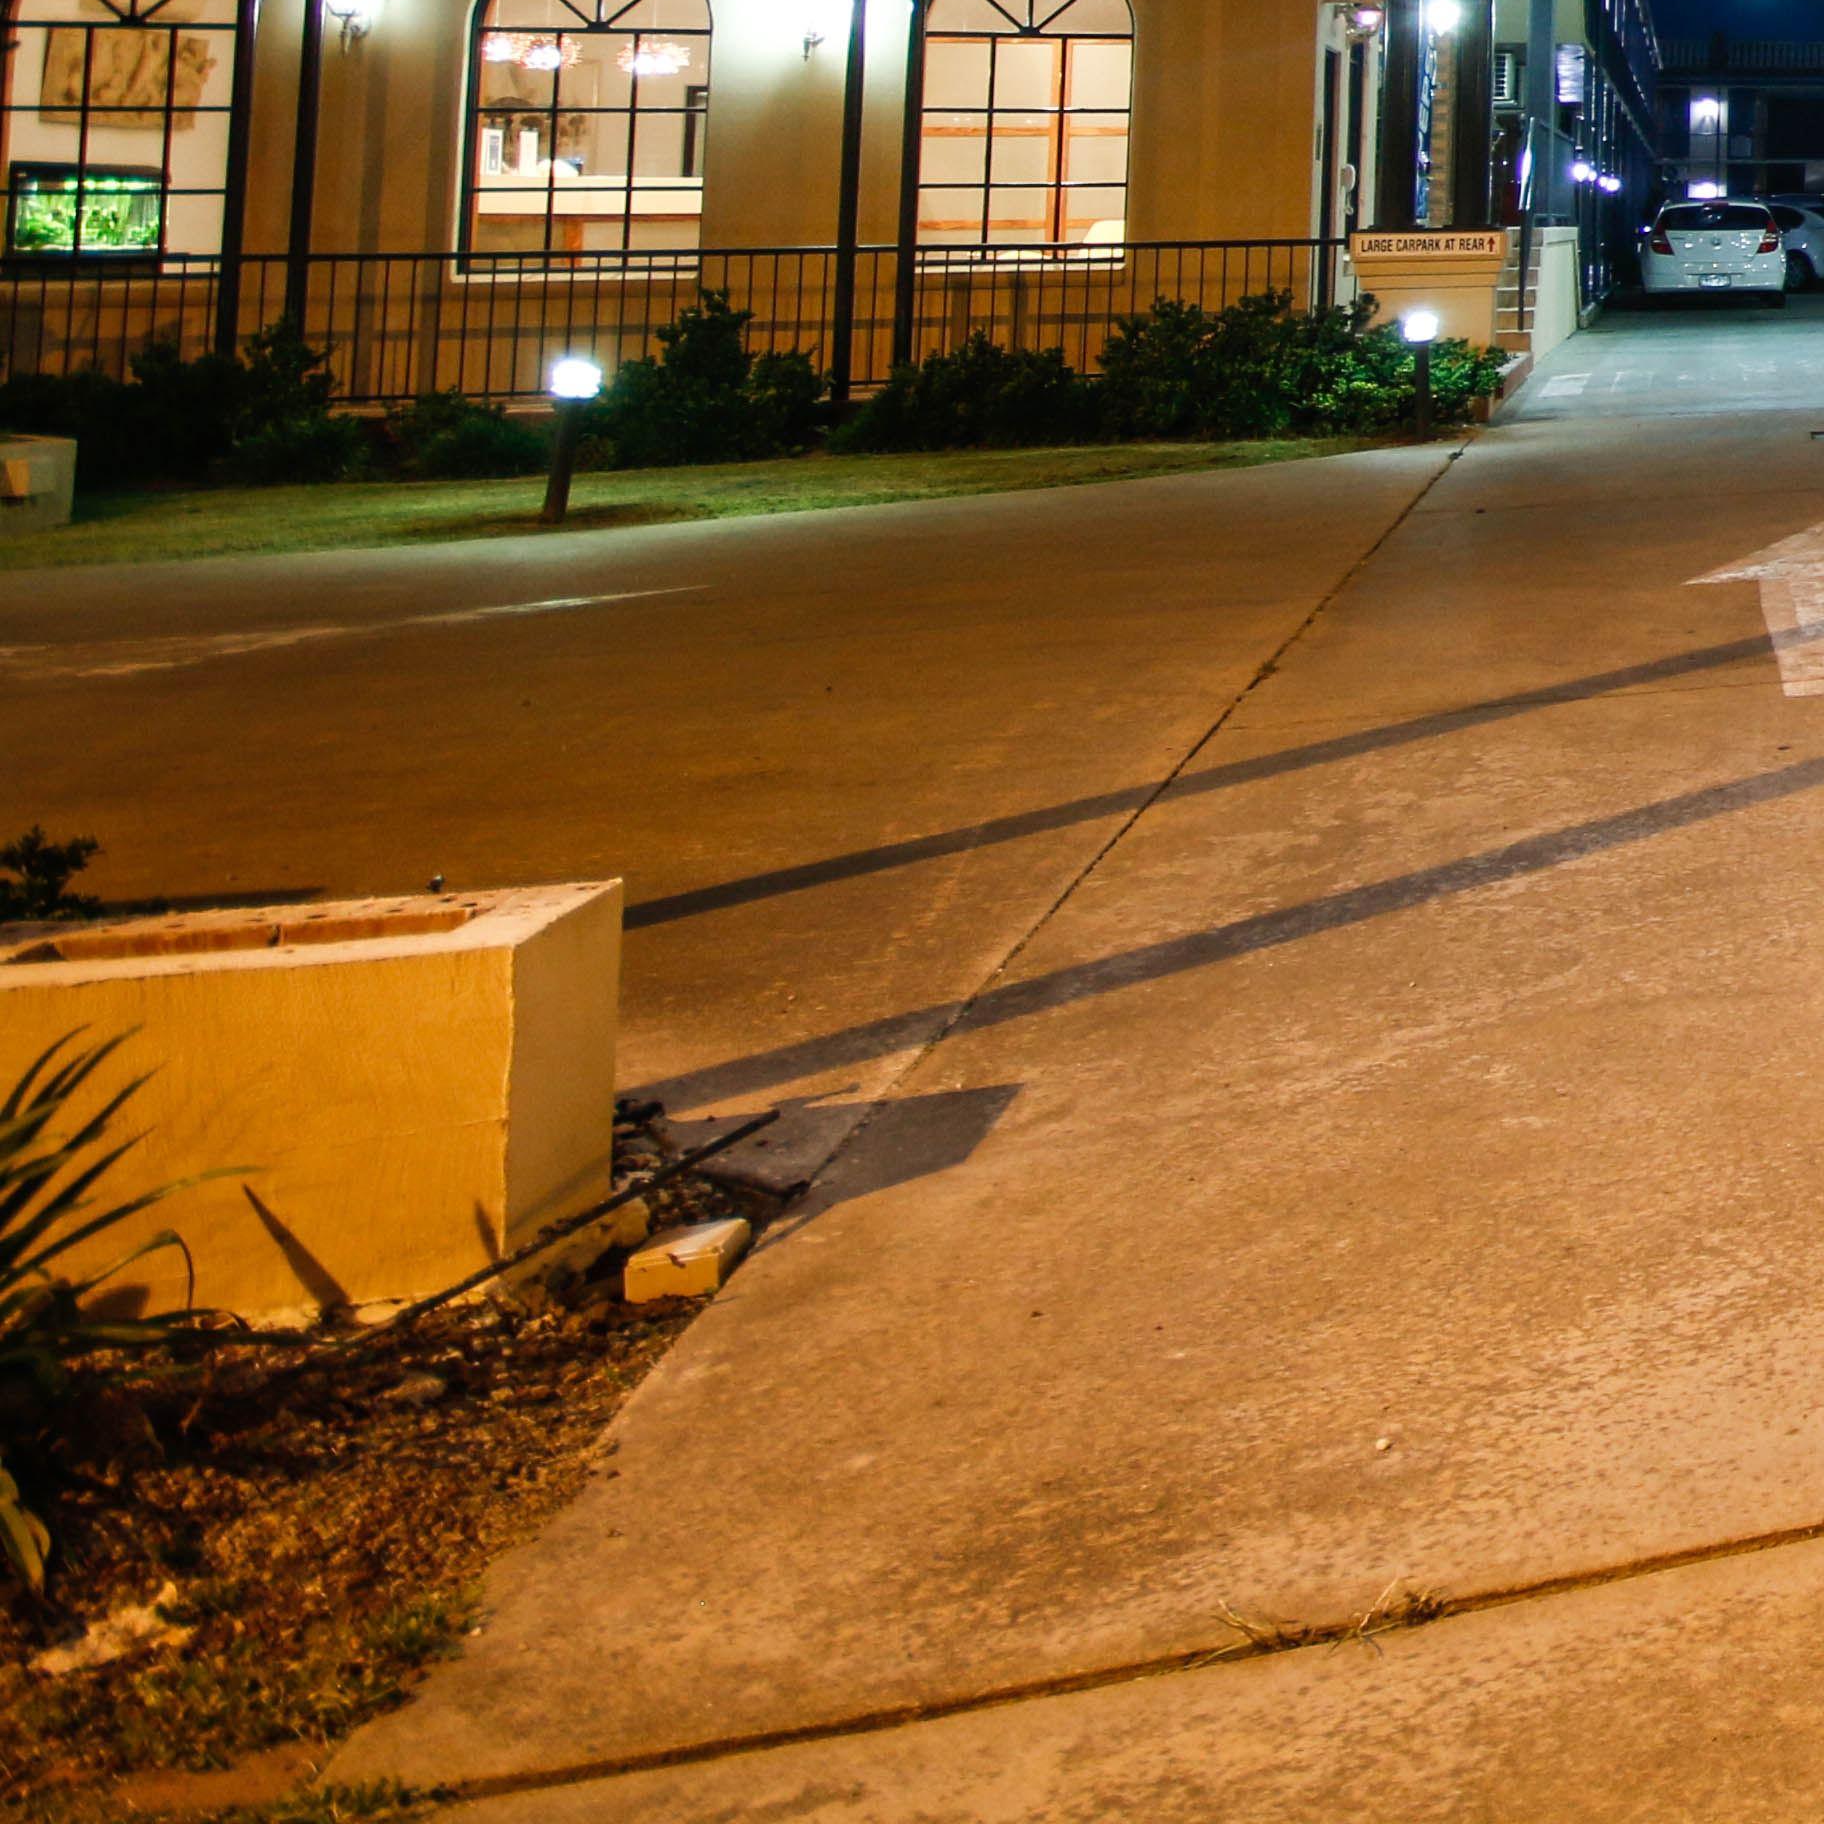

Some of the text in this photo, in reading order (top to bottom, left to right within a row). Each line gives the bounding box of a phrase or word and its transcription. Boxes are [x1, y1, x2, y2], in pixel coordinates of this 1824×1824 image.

[1361, 237, 1485, 253] LARGE CARPARK AT REAR
